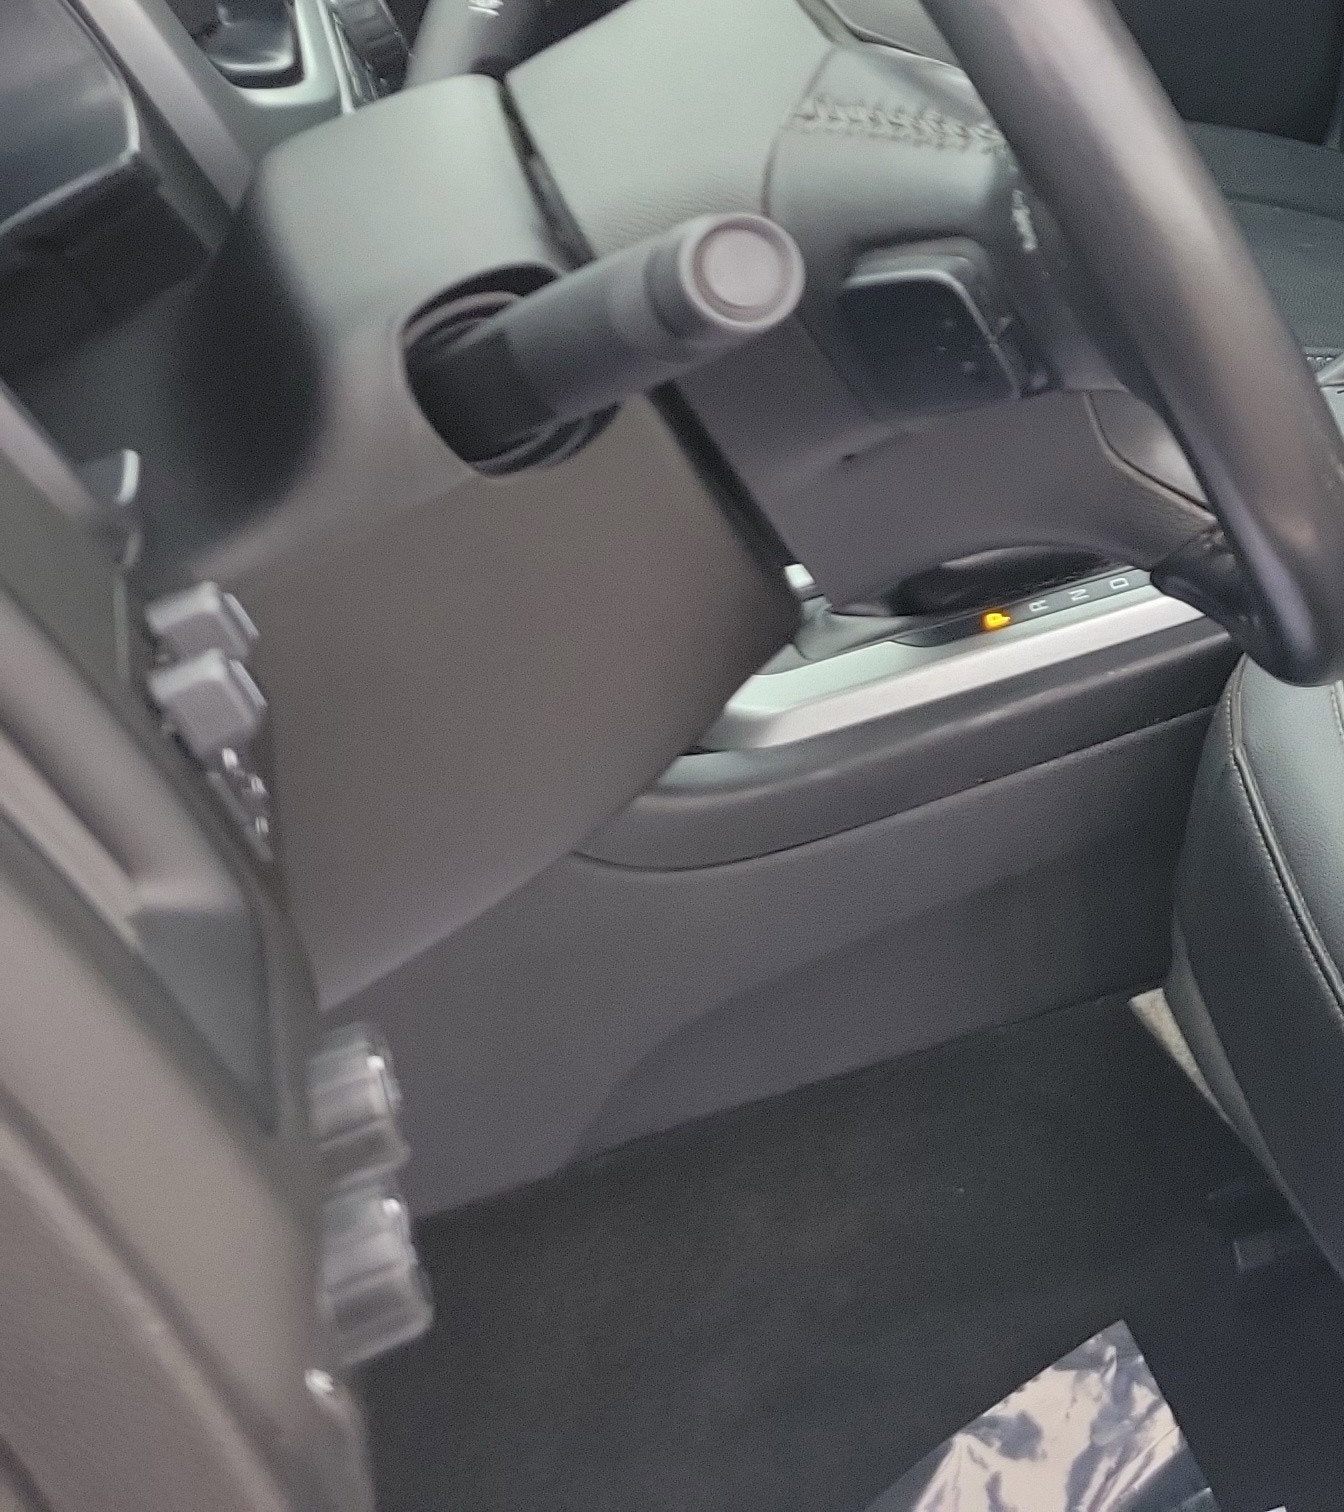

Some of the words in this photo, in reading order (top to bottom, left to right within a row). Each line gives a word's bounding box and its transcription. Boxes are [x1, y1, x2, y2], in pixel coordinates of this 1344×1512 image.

[1029, 599, 1049, 612] R
[1068, 588, 1090, 601] N
[1109, 577, 1130, 590] D
